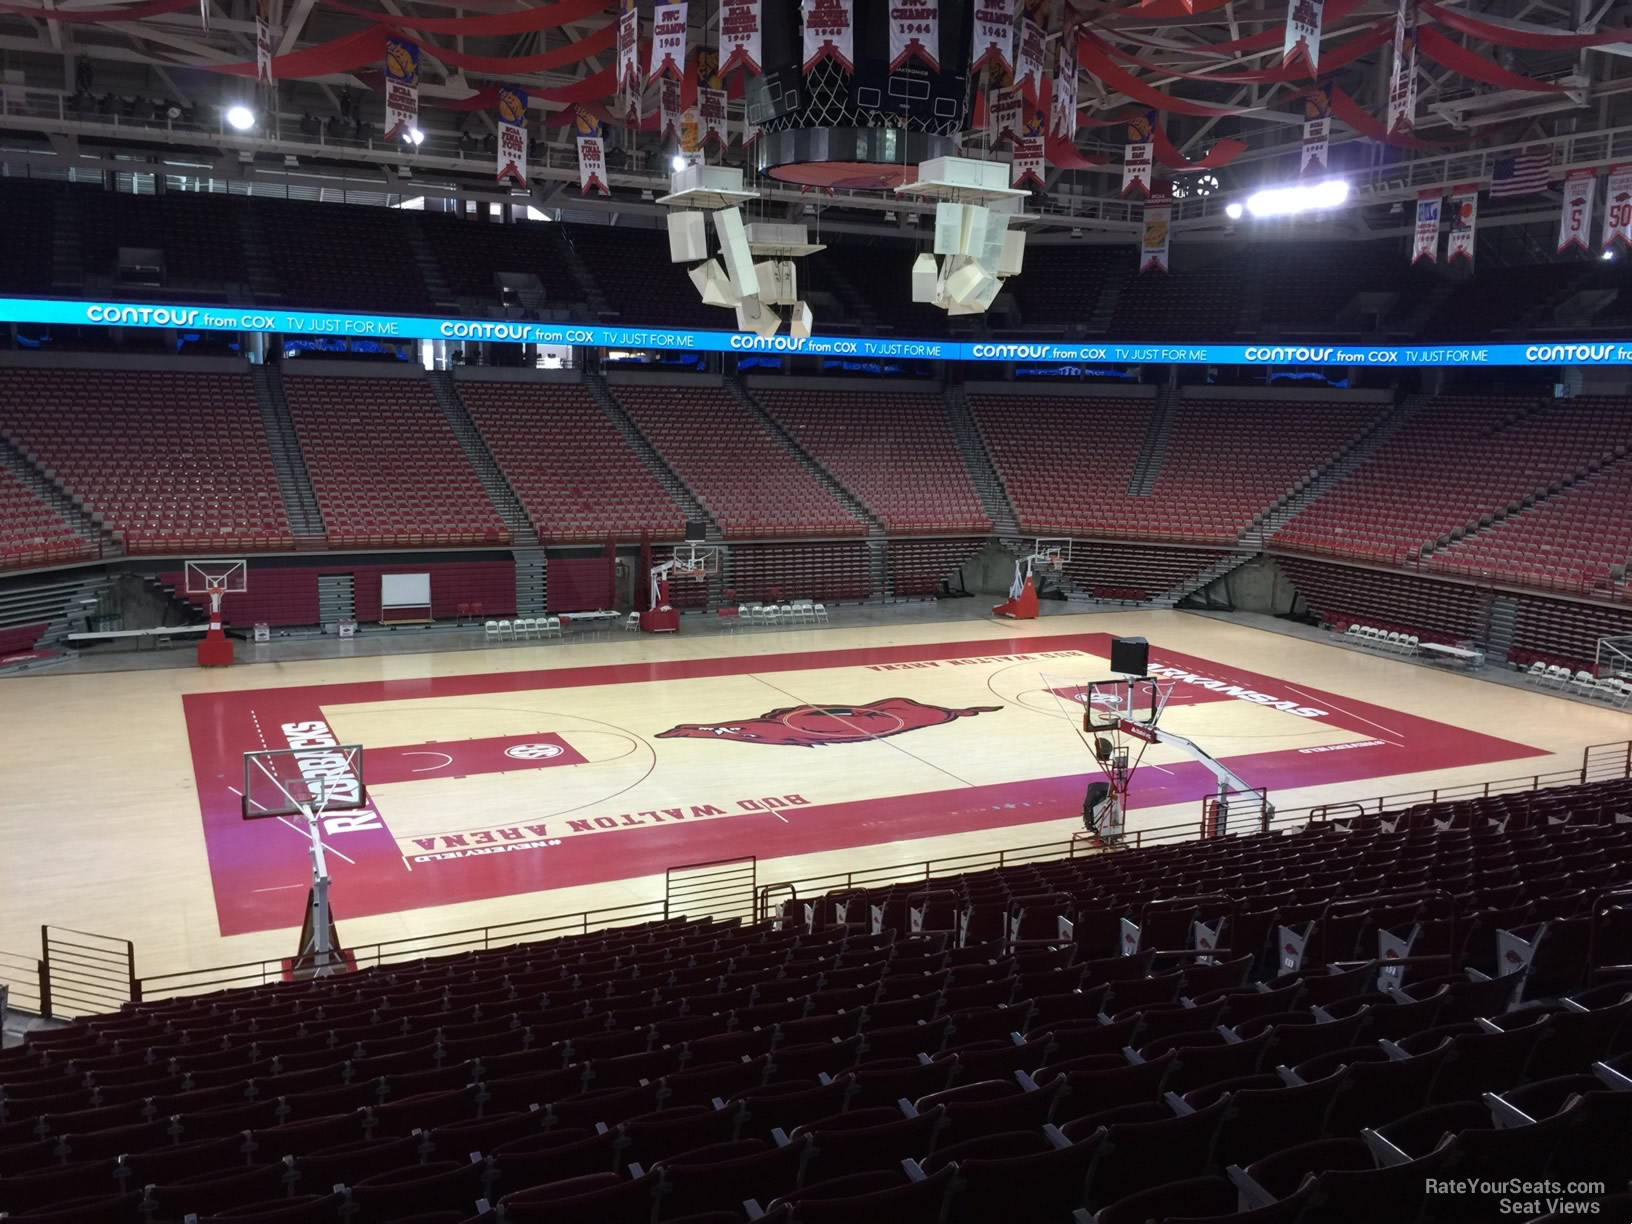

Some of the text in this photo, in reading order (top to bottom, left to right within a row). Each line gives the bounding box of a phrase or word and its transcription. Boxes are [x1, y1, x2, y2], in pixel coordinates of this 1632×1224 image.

[662, 10, 680, 22] SWC
[654, 22, 686, 36] CHAMPS
[899, 23, 931, 34] 1944
[982, 25, 1008, 38] 1942
[1571, 209, 1583, 231] 5
[1609, 204, 1632, 228] 50
[203, 313, 237, 328] from
[241, 315, 275, 329] COX
[287, 317, 399, 335] TV JUST FOR ME
[535, 328, 563, 342] from
[566, 331, 594, 343] COX
[603, 332, 695, 347] TV JUST FOR ME
[808, 341, 832, 352] from
[833, 343, 857, 353] COX
[864, 343, 941, 356] TV JUST FOR ME
[1052, 348, 1077, 359] from
[1080, 349, 1106, 360] COX
[1115, 349, 1207, 361] TV JUST FOR ME
[1336, 350, 1365, 363] from
[1368, 351, 1398, 363] COX
[1405, 350, 1488, 362] TV JUST FOR ME
[1147, 663, 1329, 718] ARKANSAS
[412, 794, 812, 851] BUD WALTON ARENA
[414, 839, 562, 864] #NEVERYIELD
